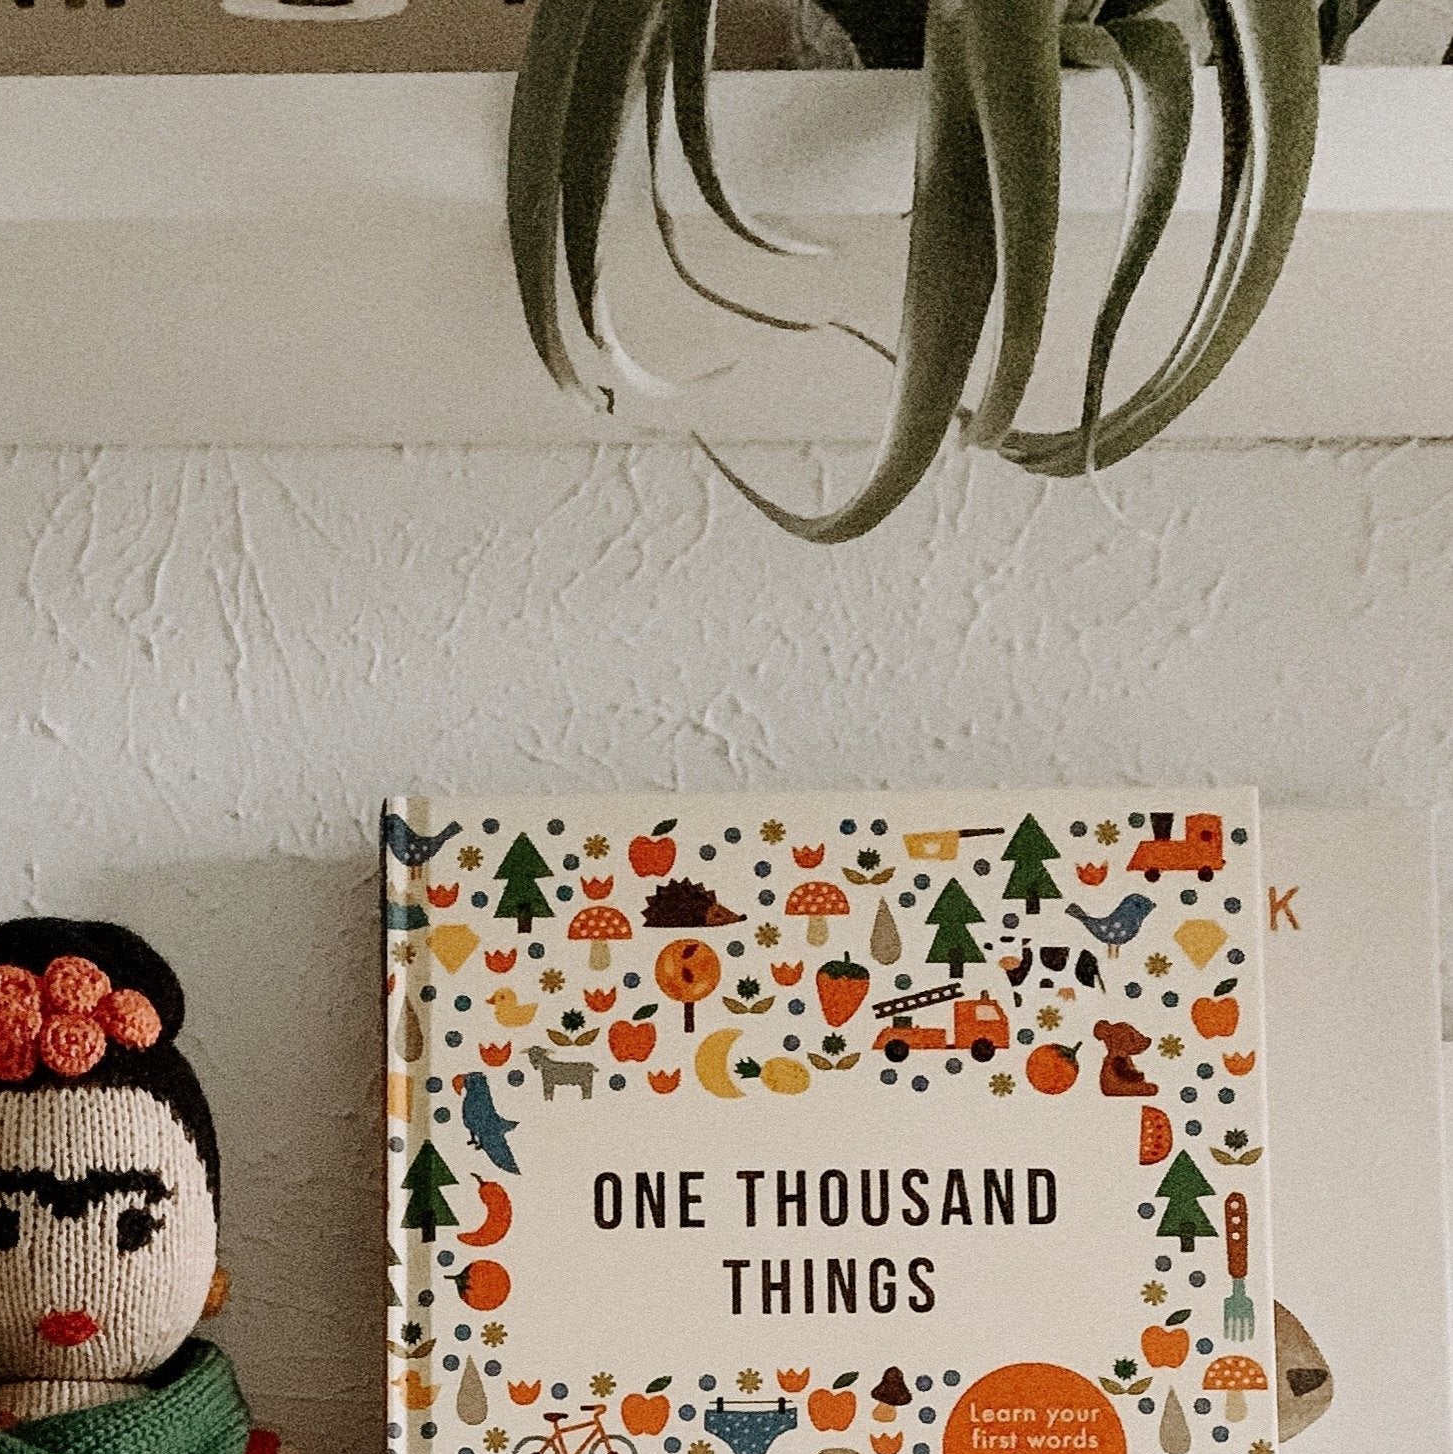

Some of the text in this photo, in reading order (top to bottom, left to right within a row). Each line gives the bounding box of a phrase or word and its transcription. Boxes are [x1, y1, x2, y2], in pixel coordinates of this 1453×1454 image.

[594, 1168, 1058, 1230] ONE THOUSAND
[722, 1256, 936, 1315] THINGS
[970, 1402, 1100, 1428] Learn your
[972, 1427, 1099, 1449] first words
